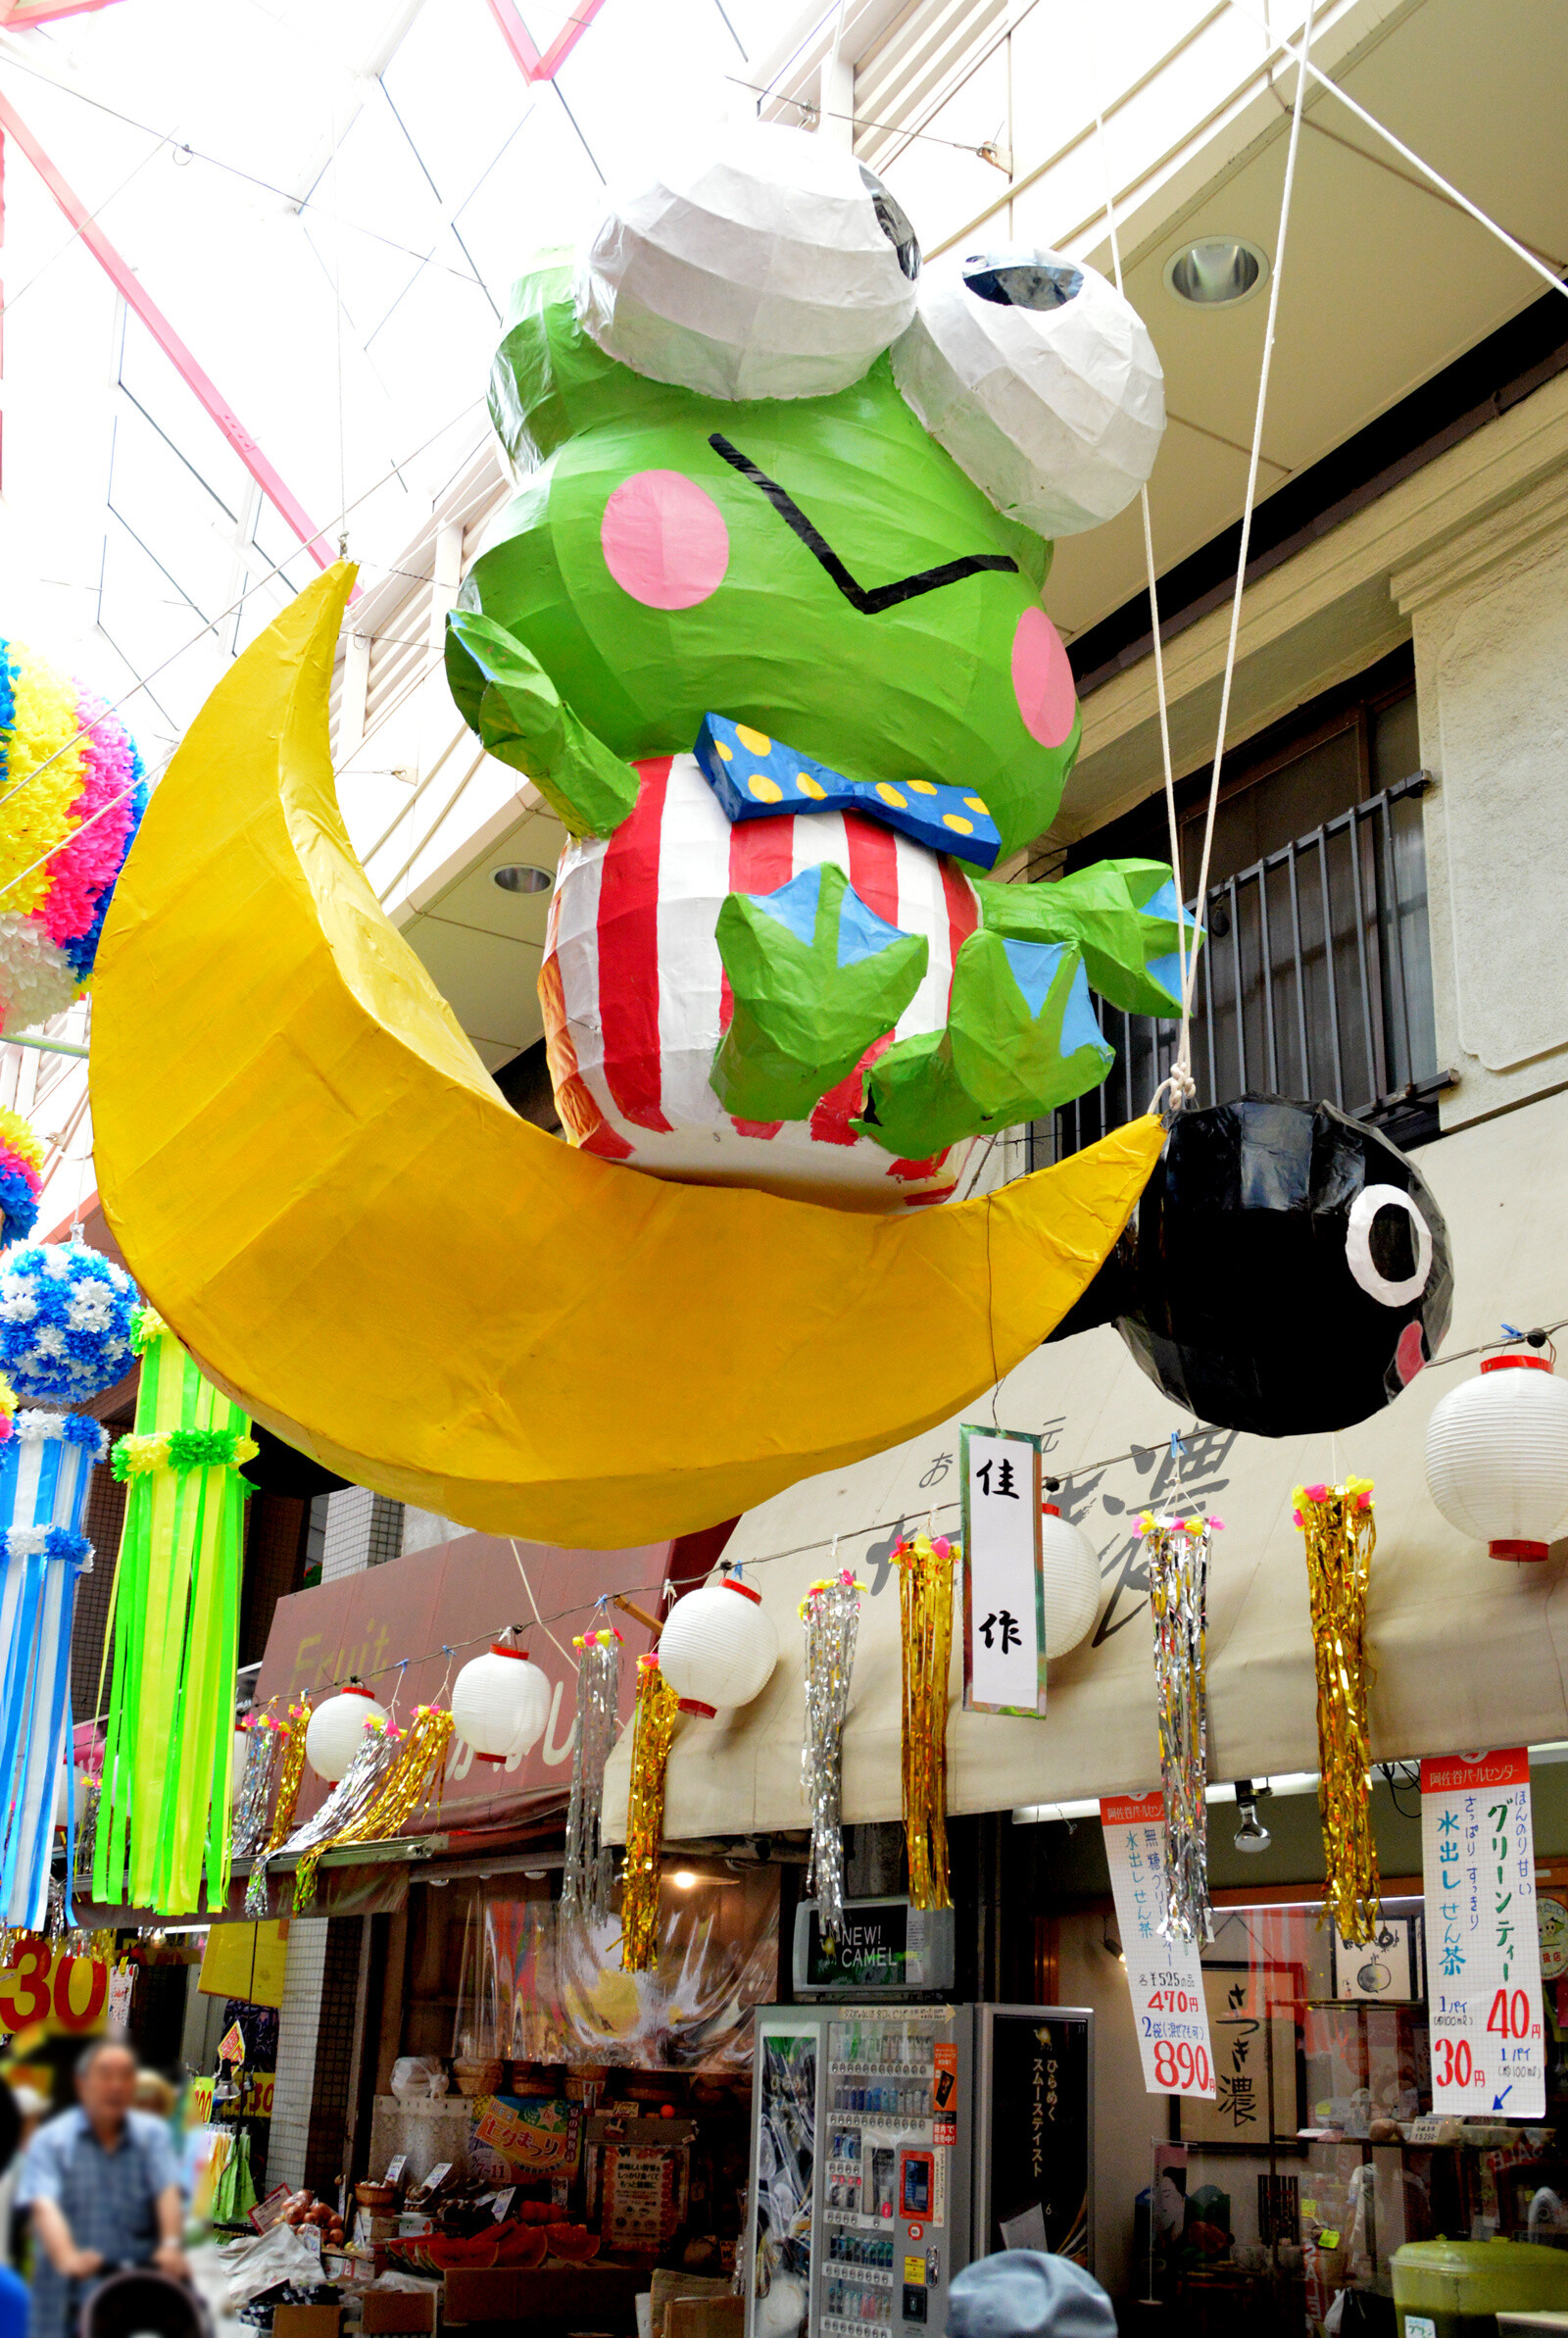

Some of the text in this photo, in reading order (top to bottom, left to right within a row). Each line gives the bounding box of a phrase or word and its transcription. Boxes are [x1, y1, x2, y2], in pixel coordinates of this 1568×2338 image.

[976, 1458, 1022, 1655] 佳作
[290, 1617, 389, 1694] Fruit
[1430, 1765, 1519, 1787] 阿佐谷パールセンター
[1106, 1804, 1164, 1820] 阿佐谷パールセン
[1515, 1790, 1532, 1896] ほんのり甘い
[1488, 1798, 1515, 1982] グリーンティー
[842, 1925, 881, 1946] NEW!
[842, 1947, 898, 1967] CAMEL
[1148, 1990, 1199, 2013] 470円
[1487, 1988, 1541, 2040] 40円
[1153, 2040, 1216, 2092] 890円
[1215, 1983, 1260, 2127] さつき濃
[1435, 2038, 1486, 2088] 30円
[1047, 2059, 1058, 2121] ひらめく
[484, 2117, 561, 2158] 七夕まつり
[1032, 2059, 1044, 2178] スムーステイスト
